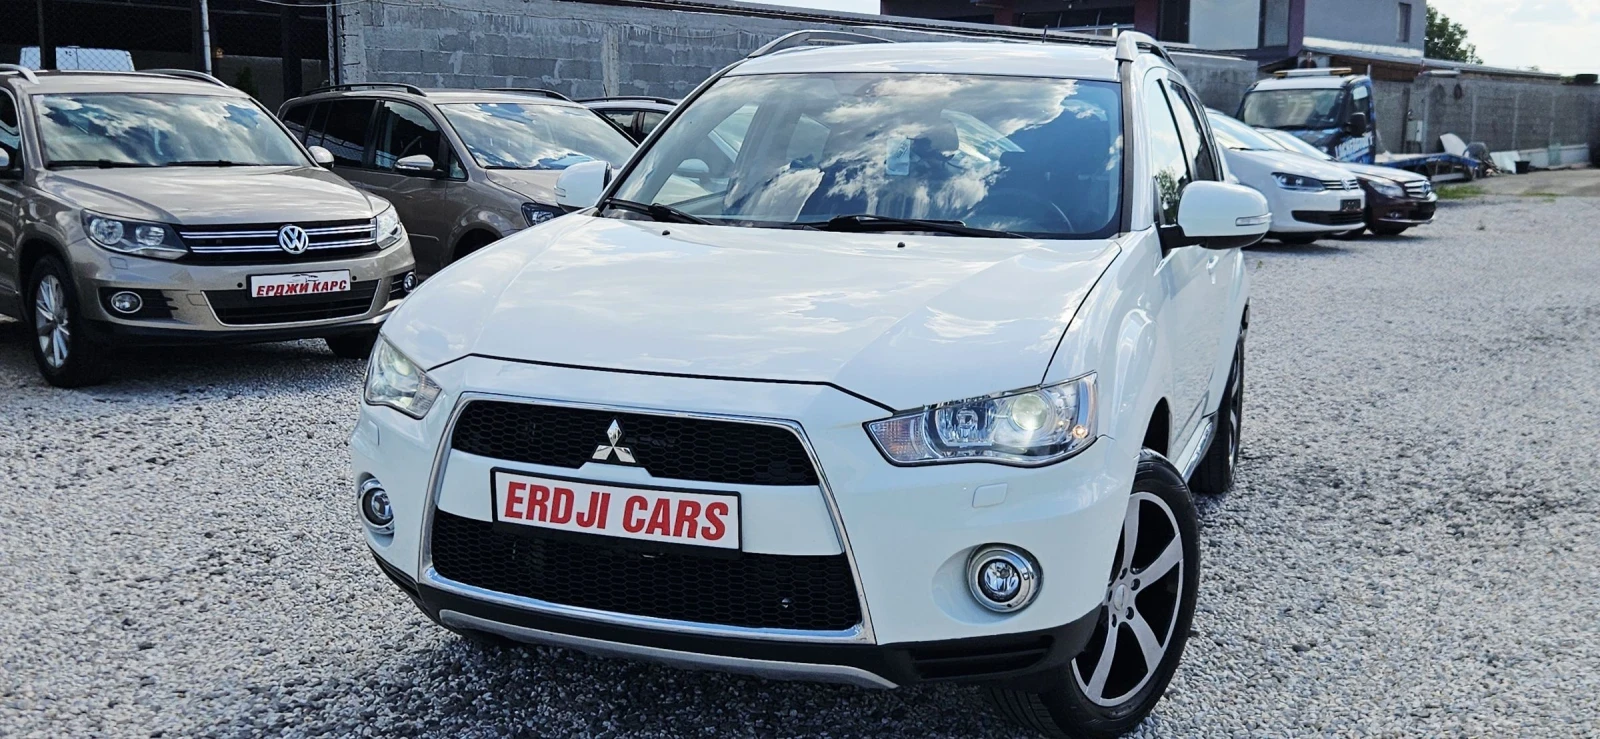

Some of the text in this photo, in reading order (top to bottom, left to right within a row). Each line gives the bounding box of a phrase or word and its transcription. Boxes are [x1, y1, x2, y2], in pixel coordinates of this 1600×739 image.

[256, 280, 347, 297] ЕРДЖИ КАРС
[504, 481, 729, 541] ERDJI CARS
